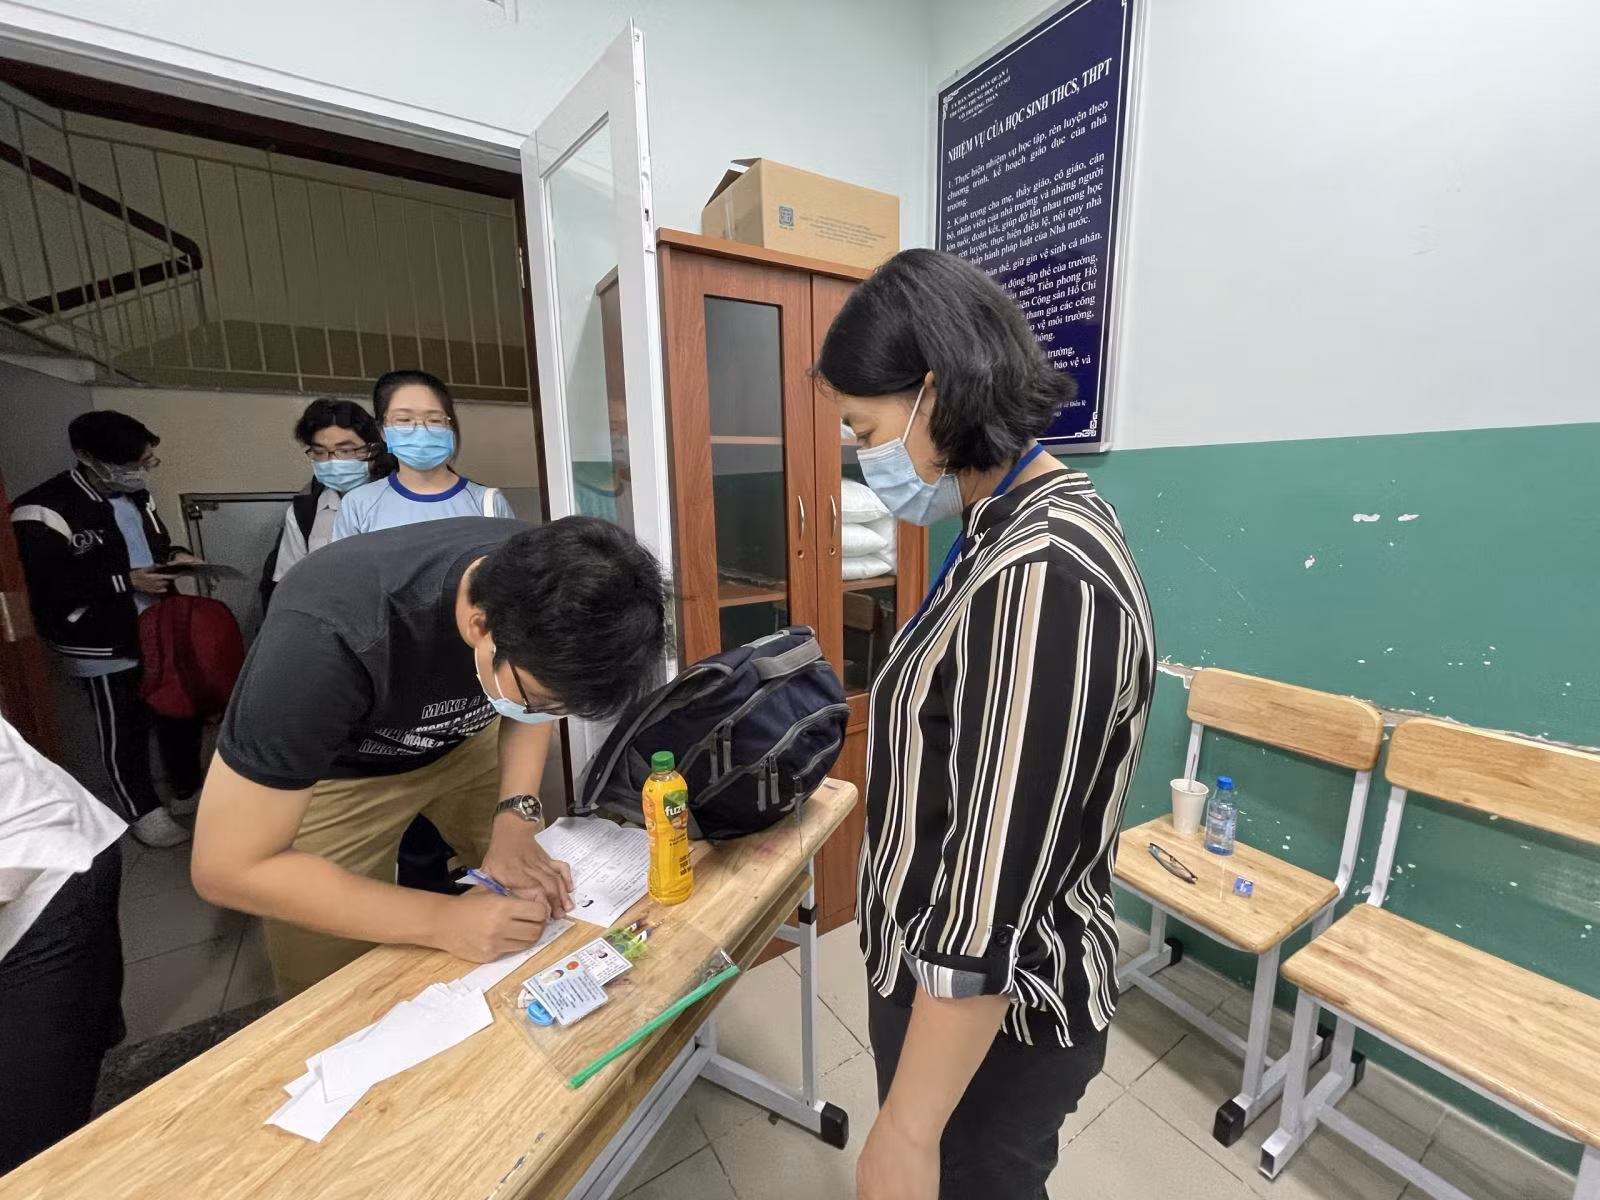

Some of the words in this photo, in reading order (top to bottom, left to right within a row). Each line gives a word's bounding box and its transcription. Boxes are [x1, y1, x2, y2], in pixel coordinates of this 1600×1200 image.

[947, 137, 973, 163] NHIỆM
[974, 130, 986, 148] VỤ
[986, 119, 1004, 141] CỦA
[1005, 107, 1025, 131] HỌC
[1026, 93, 1049, 119] SINH
[1050, 77, 1080, 105] THCS,
[1082, 57, 1112, 88] THPT
[1018, 140, 1032, 153] học
[1063, 111, 1087, 129] luyện
[1088, 100, 1108, 116] theo
[1005, 155, 1026, 172] hoạch
[1030, 145, 1047, 162] giáo
[1050, 136, 1066, 149] dục
[1070, 126, 1086, 139] của
[969, 206, 987, 219] trọng
[987, 200, 1000, 211] cha
[1053, 169, 1064, 181] cô
[1089, 152, 1105, 166] cán
[987, 213, 999, 223] của
[1040, 189, 1049, 200] và
[1051, 179, 1076, 196] những
[1078, 165, 1104, 185] người
[1001, 217, 1017, 232] giúp
[1042, 199, 1061, 213] nhau
[1063, 190, 1085, 205] trong
[1087, 182, 1103, 195] học
[1053, 208, 1066, 222] nội
[1067, 204, 1084, 218] quy
[984, 268, 998, 276] hân
[1012, 257, 1025, 271] giữ
[1039, 248, 1049, 259] vệ
[1050, 242, 1067, 256] sinh
[1079, 231, 1103, 246] nhân.
[1001, 242, 1018, 257] pháp
[1019, 236, 1033, 248] luật
[1034, 232, 1048, 242] của
[1007, 277, 1026, 288] động
[1026, 272, 1038, 283] tập
[1039, 266, 1051, 278] thể
[1052, 263, 1067, 274] của
[1019, 286, 1035, 297] niên
[1037, 278, 1054, 292] Tiền
[1056, 272, 1081, 289] phong
[1084, 265, 1098, 278] Hồ
[1031, 294, 1051, 306] Cộng
[1067, 284, 1080, 296] Hồ
[1081, 279, 1096, 292] Chí
[1026, 309, 1044, 320] tham
[1046, 304, 1058, 317] gia
[1059, 300, 1073, 311] các
[1075, 295, 1095, 307] công
[1037, 319, 1046, 330] vệ
[1048, 314, 1063, 327] môi
[1033, 332, 1055, 342] hông.
[1070, 356, 1080, 368] vệ
[421, 698, 468, 720] MAKE
